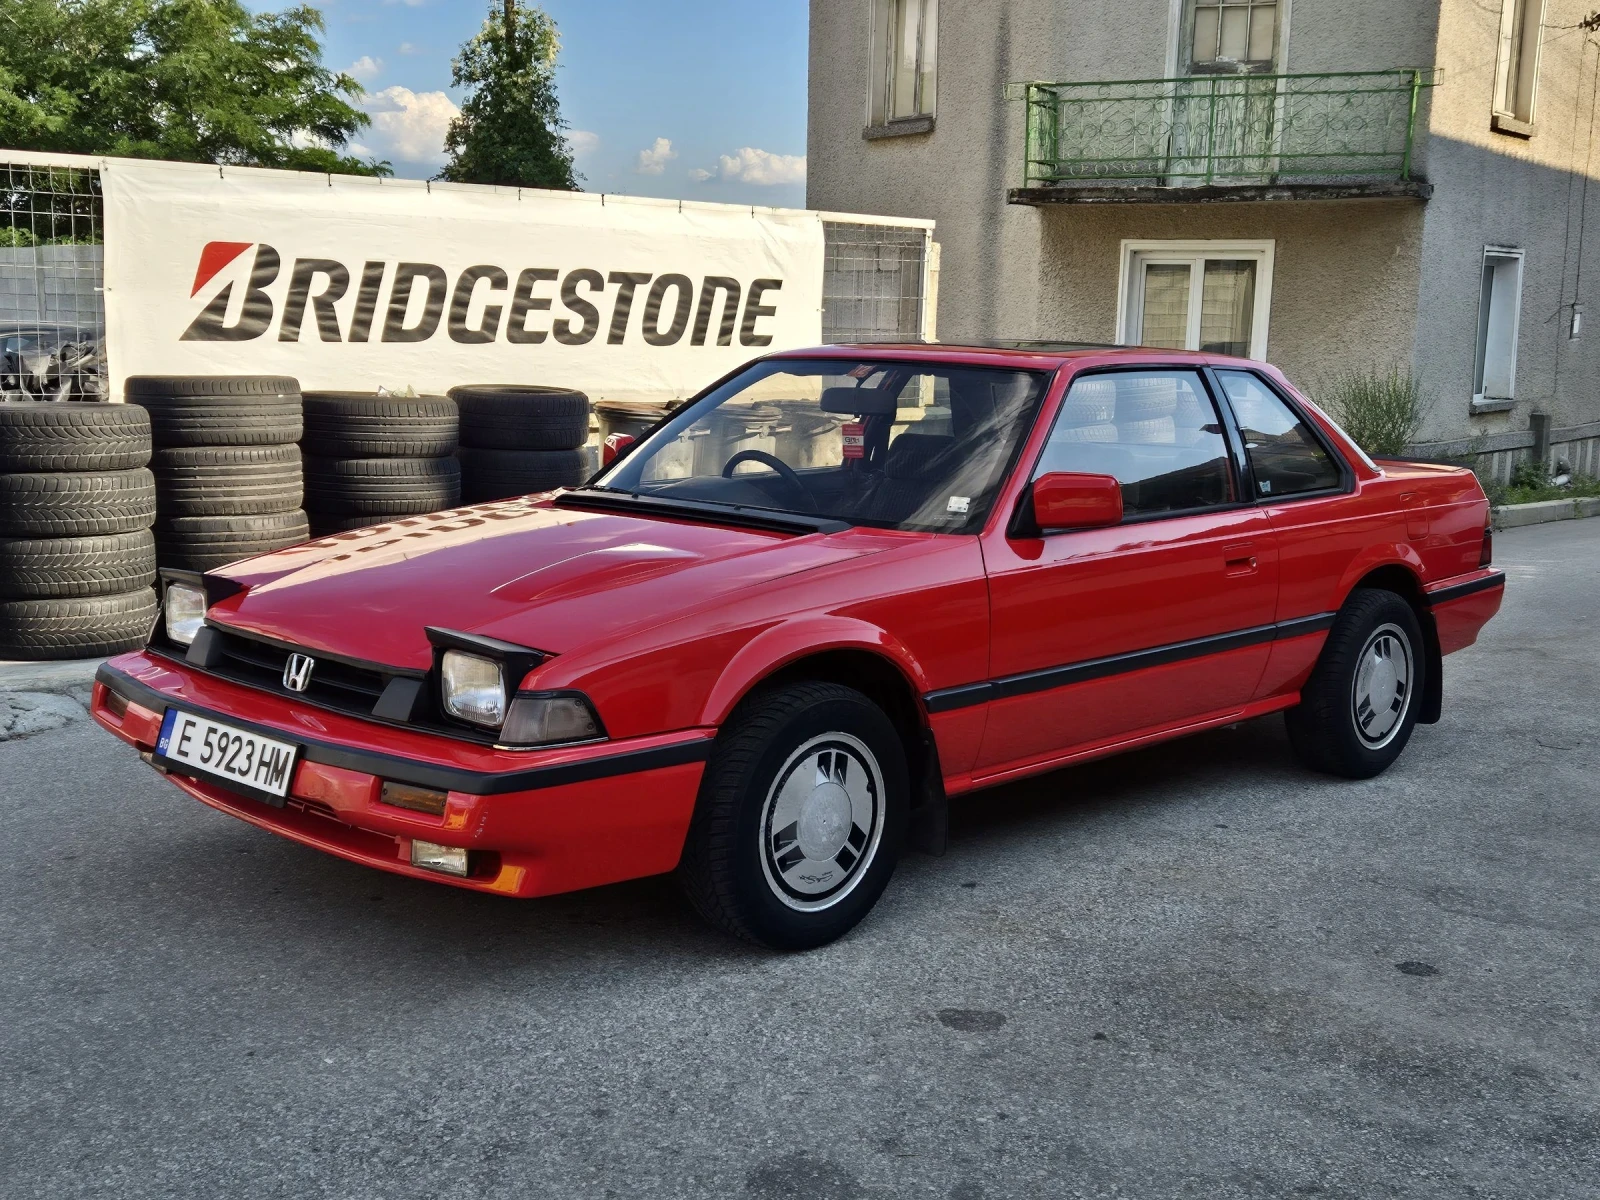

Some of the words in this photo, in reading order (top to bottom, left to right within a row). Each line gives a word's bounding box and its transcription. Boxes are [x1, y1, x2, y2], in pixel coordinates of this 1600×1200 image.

[178, 241, 783, 347] BRIDGESTONE
[159, 737, 169, 749] BG
[177, 719, 196, 757] E
[200, 726, 255, 777] 5923
[254, 743, 290, 789] HM
